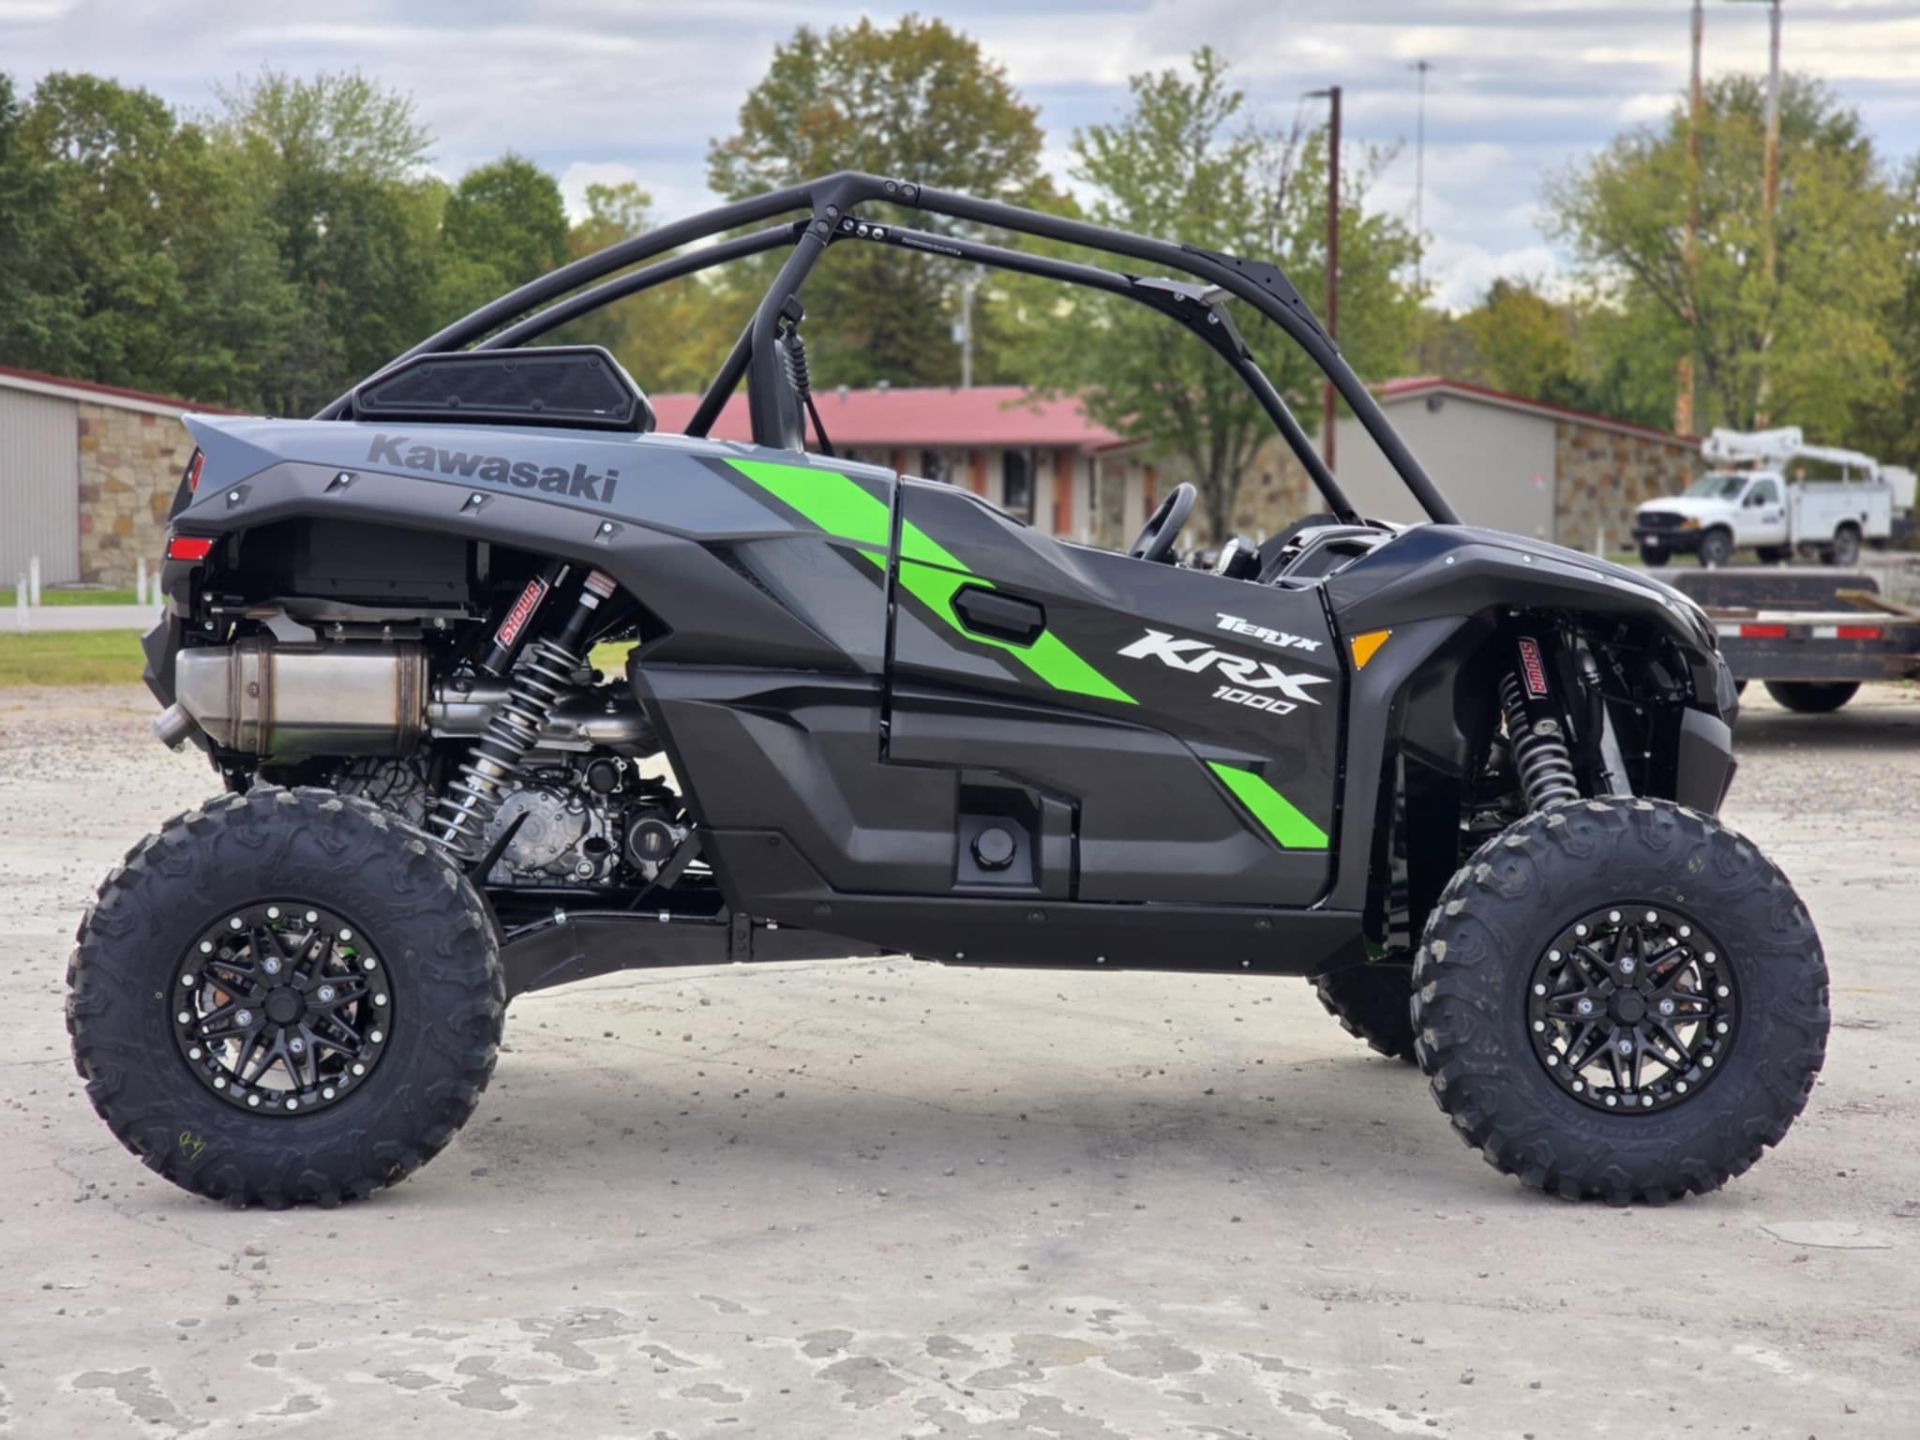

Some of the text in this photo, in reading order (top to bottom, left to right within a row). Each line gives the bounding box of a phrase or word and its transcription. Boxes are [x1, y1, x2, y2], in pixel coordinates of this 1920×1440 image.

[366, 434, 620, 504] Kawasaki
[500, 579, 542, 647] SHOWA
[1117, 628, 1333, 705] KRX
[1211, 685, 1298, 715] 1000
[1520, 641, 1547, 693] SHOWA
